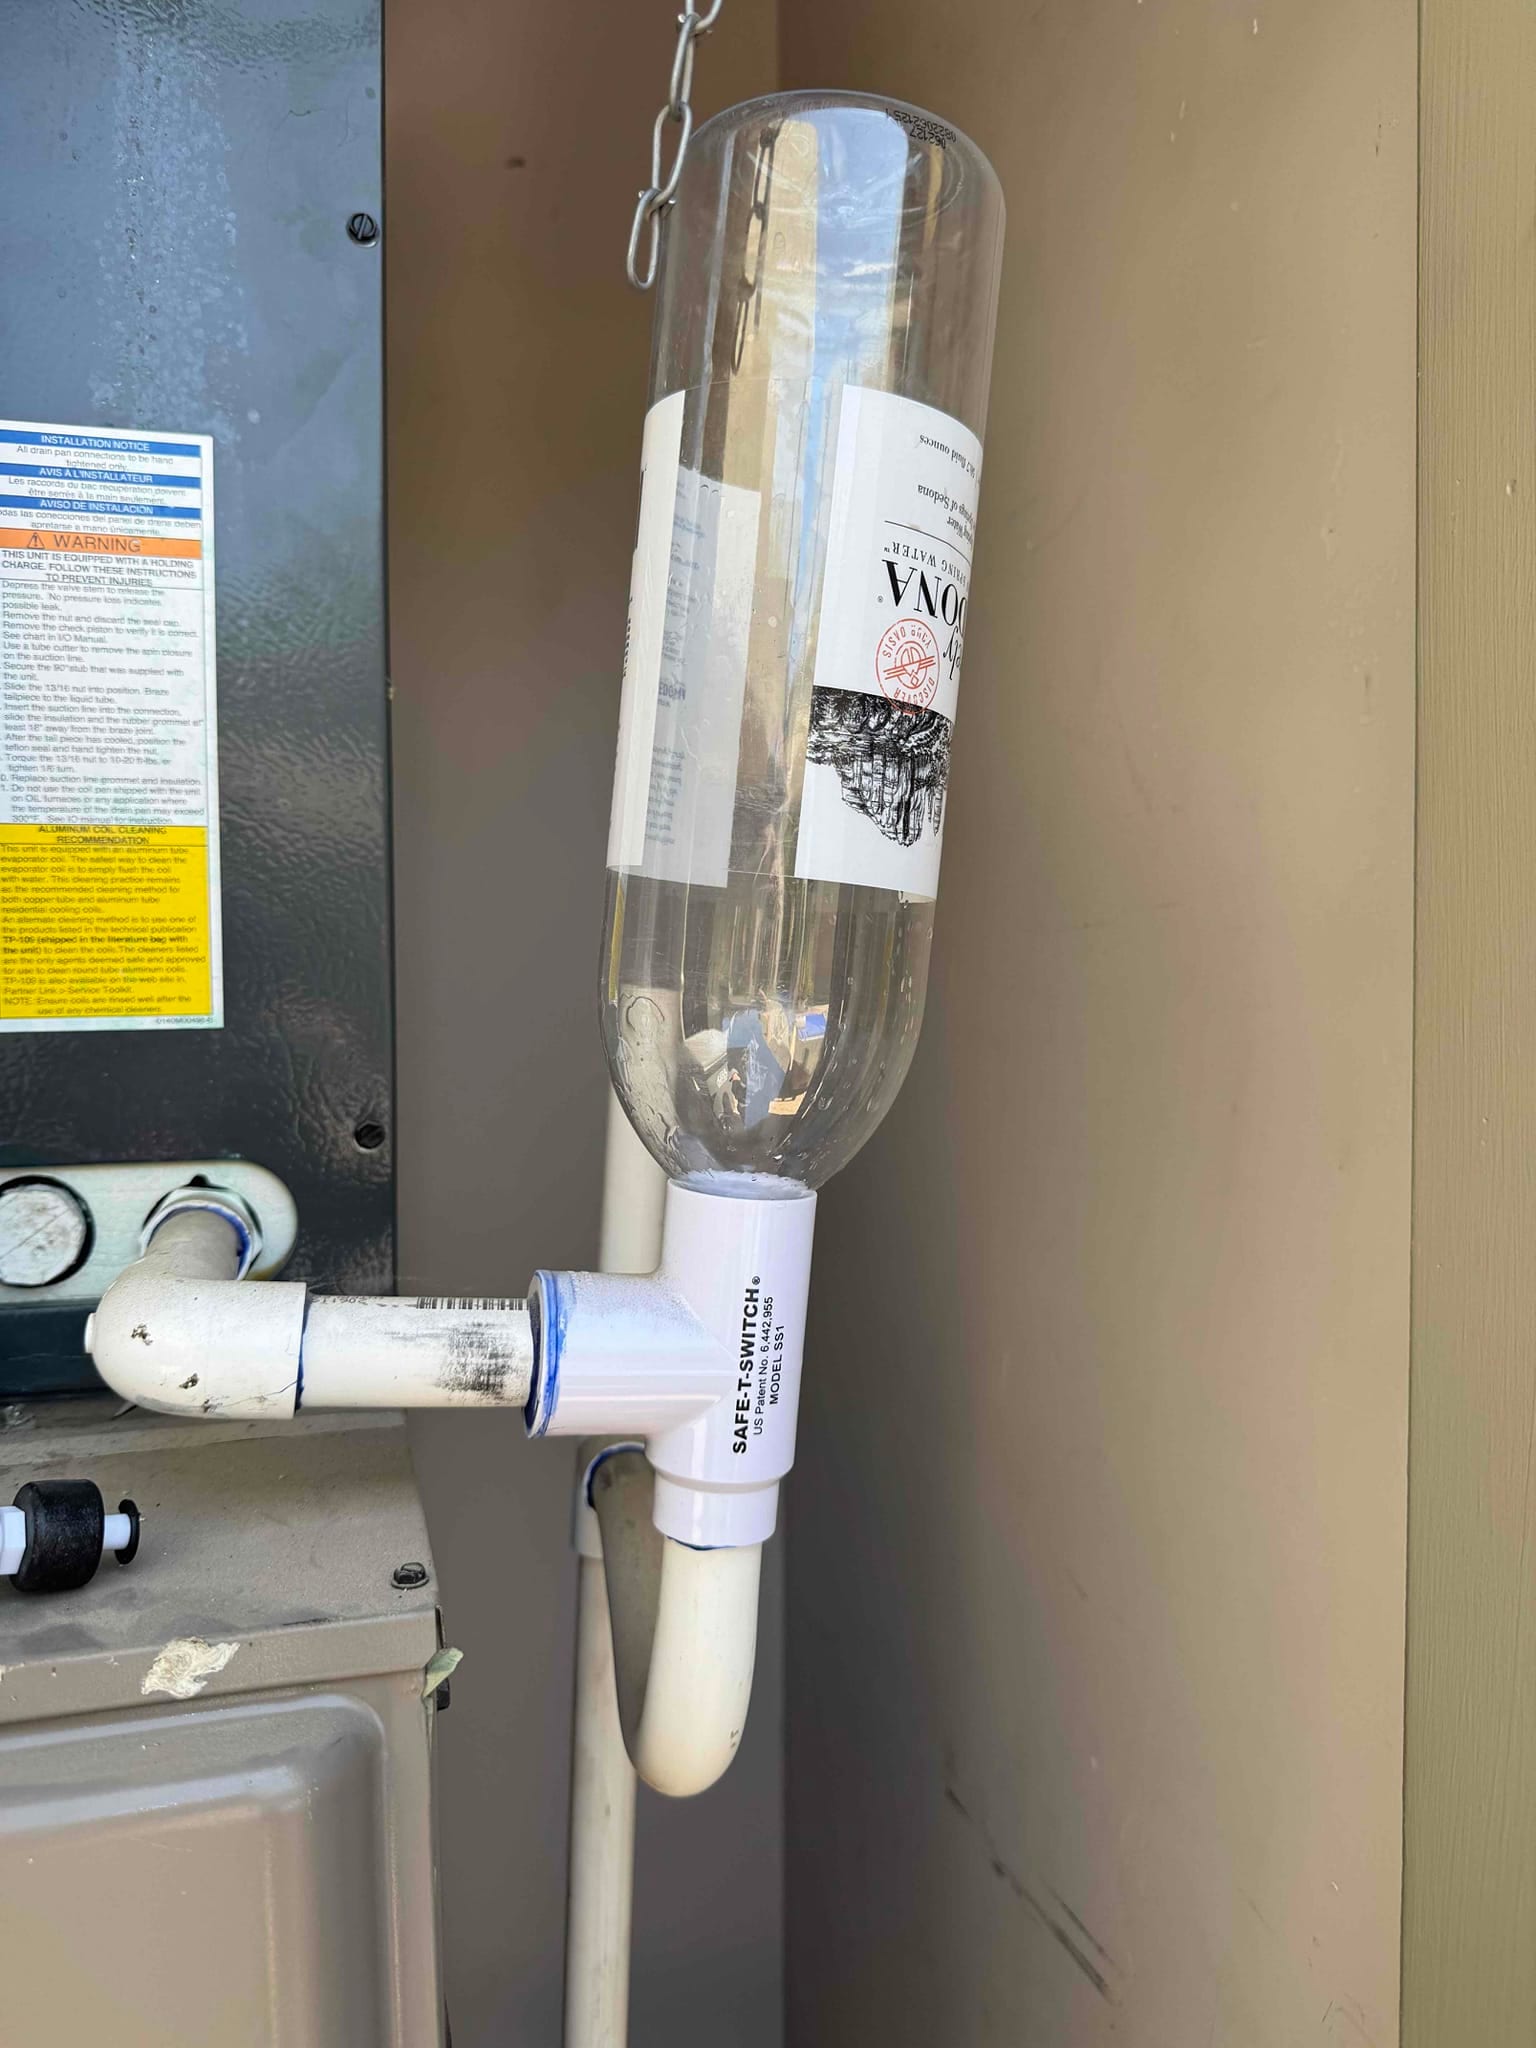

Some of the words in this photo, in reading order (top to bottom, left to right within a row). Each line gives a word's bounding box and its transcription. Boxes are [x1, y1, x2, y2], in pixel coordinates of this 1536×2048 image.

[41, 435, 111, 448] INSTALLATION
[113, 440, 150, 451] NOTICE
[920, 434, 949, 454] ounces
[16, 445, 28, 453] All
[30, 446, 52, 455] drain
[54, 449, 71, 458] pan
[73, 449, 125, 460] connections
[127, 453, 136, 461] to
[138, 454, 149, 462] be
[151, 455, 173, 463] hand
[65, 459, 106, 469] tightened
[39, 467, 63, 477] AVIS
[74, 470, 153, 483] L'INSTALLATEUR
[8, 476, 25, 485] Les
[27, 478, 65, 488] raccords
[67, 480, 79, 489] du
[81, 481, 97, 490] bac
[96, 492, 117, 500] main
[918, 484, 950, 509] Sedona
[40, 499, 70, 509] AVISO
[73, 501, 87, 510] DE
[950, 500, 958, 512] of
[0, 508, 18, 517] odas
[20, 510, 34, 518] las
[93, 514, 105, 522] del
[53, 534, 140, 552] WARNING
[2, 550, 24, 559] THIS
[27, 551, 48, 560] UNIT
[51, 553, 61, 561] IS
[63, 553, 113, 563] EQUIPPED
[115, 556, 138, 565] WITH
[151, 558, 193, 568] HOLDING
[49, 563, 89, 573] FOLLOW
[93, 565, 124, 574] THESE
[127, 567, 196, 578] INSTRUCTIONS
[46, 573, 59, 582] TO
[62, 574, 106, 584] PREVENT
[109, 576, 152, 586] INJURIES
[2, 581, 39, 591] Depress
[83, 585, 104, 593] stem
[48, 593, 61, 601] No
[63, 595, 101, 604] pressure
[2, 600, 38, 611] possible
[3, 611, 40, 619] Remove
[42, 612, 56, 620] the
[58, 613, 73, 621] nut
[75, 614, 92, 622] and
[93, 615, 125, 623] discard
[127, 616, 140, 624] the
[3, 621, 40, 630] Remove
[2, 631, 21, 640] See
[23, 632, 46, 641] chart
[47, 633, 56, 641] in
[882, 626, 906, 658] OASIS
[3, 642, 21, 650] Use
[31, 643, 51, 651] tube
[17, 652, 31, 660] the
[33, 653, 65, 661] suction
[3, 682, 26, 690] Slide
[28, 683, 42, 691] the
[53, 694, 67, 702] the
[38, 824, 90, 833] ALUMINUM
[92, 825, 115, 833] COIL
[118, 825, 167, 833] CLEANING
[56, 835, 149, 844] RECOMMENDATION
[760, 1297, 774, 1352] 6,442,955
[774, 1325, 785, 1352] SS1
[759, 1355, 769, 1377] No.
[769, 1354, 782, 1405] MODEL
[755, 1379, 767, 1415] Patent
[754, 1418, 763, 1435] US
